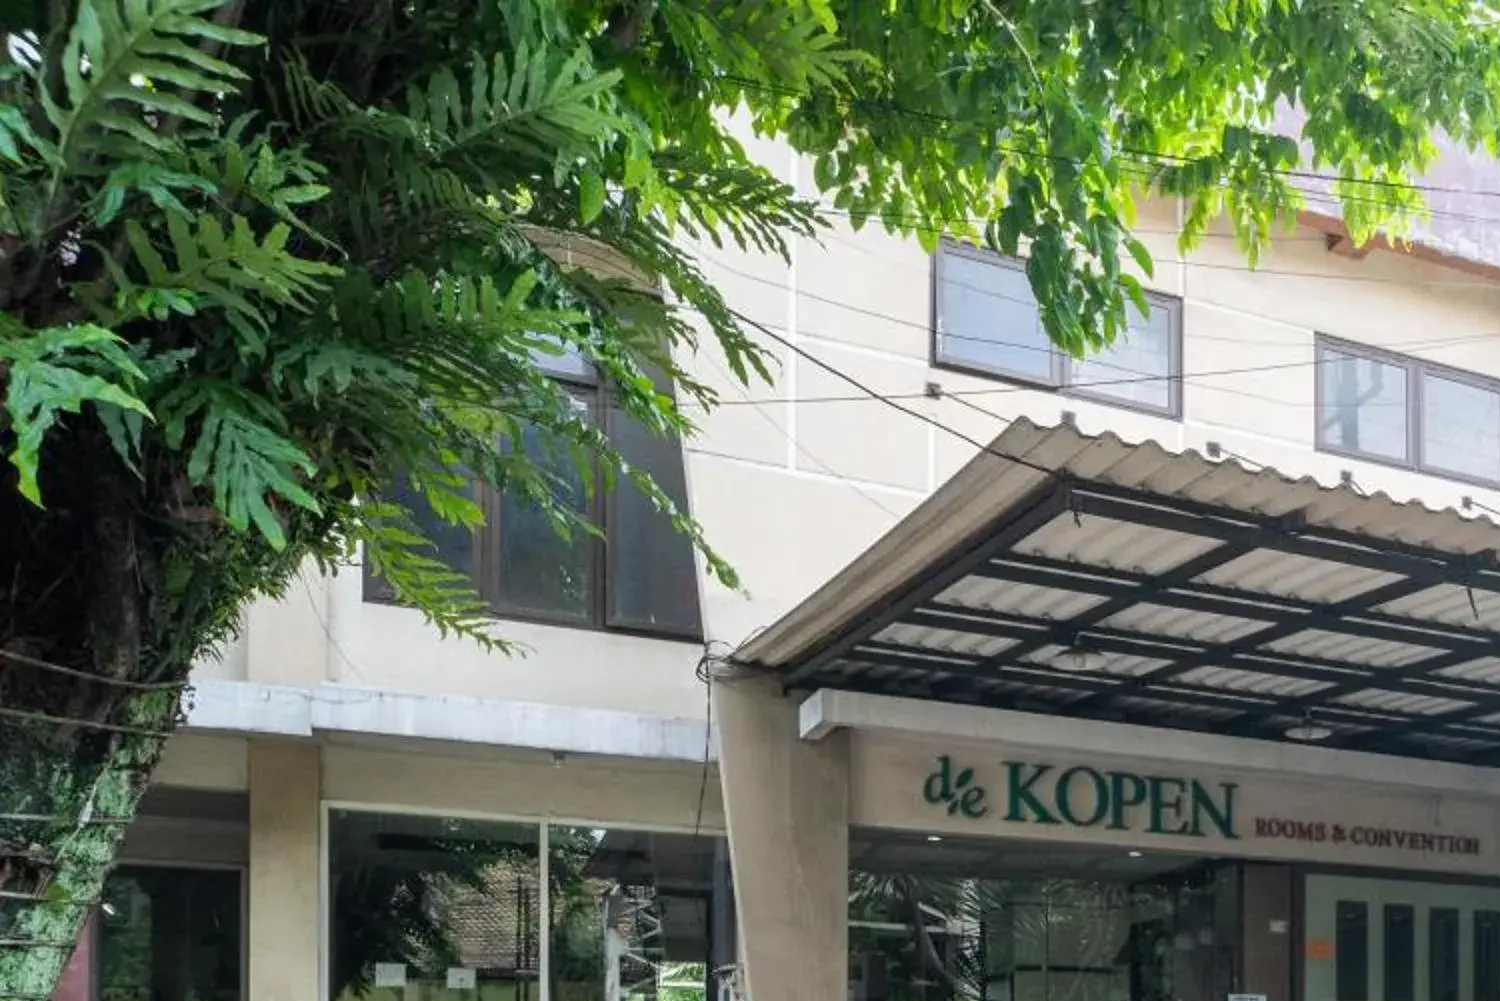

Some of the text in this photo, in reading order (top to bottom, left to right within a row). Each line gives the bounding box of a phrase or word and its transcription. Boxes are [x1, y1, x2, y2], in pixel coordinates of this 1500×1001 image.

[1001, 761, 1241, 840] KOPEN
[1255, 817, 1481, 856] ROOMS & CONVENTION
